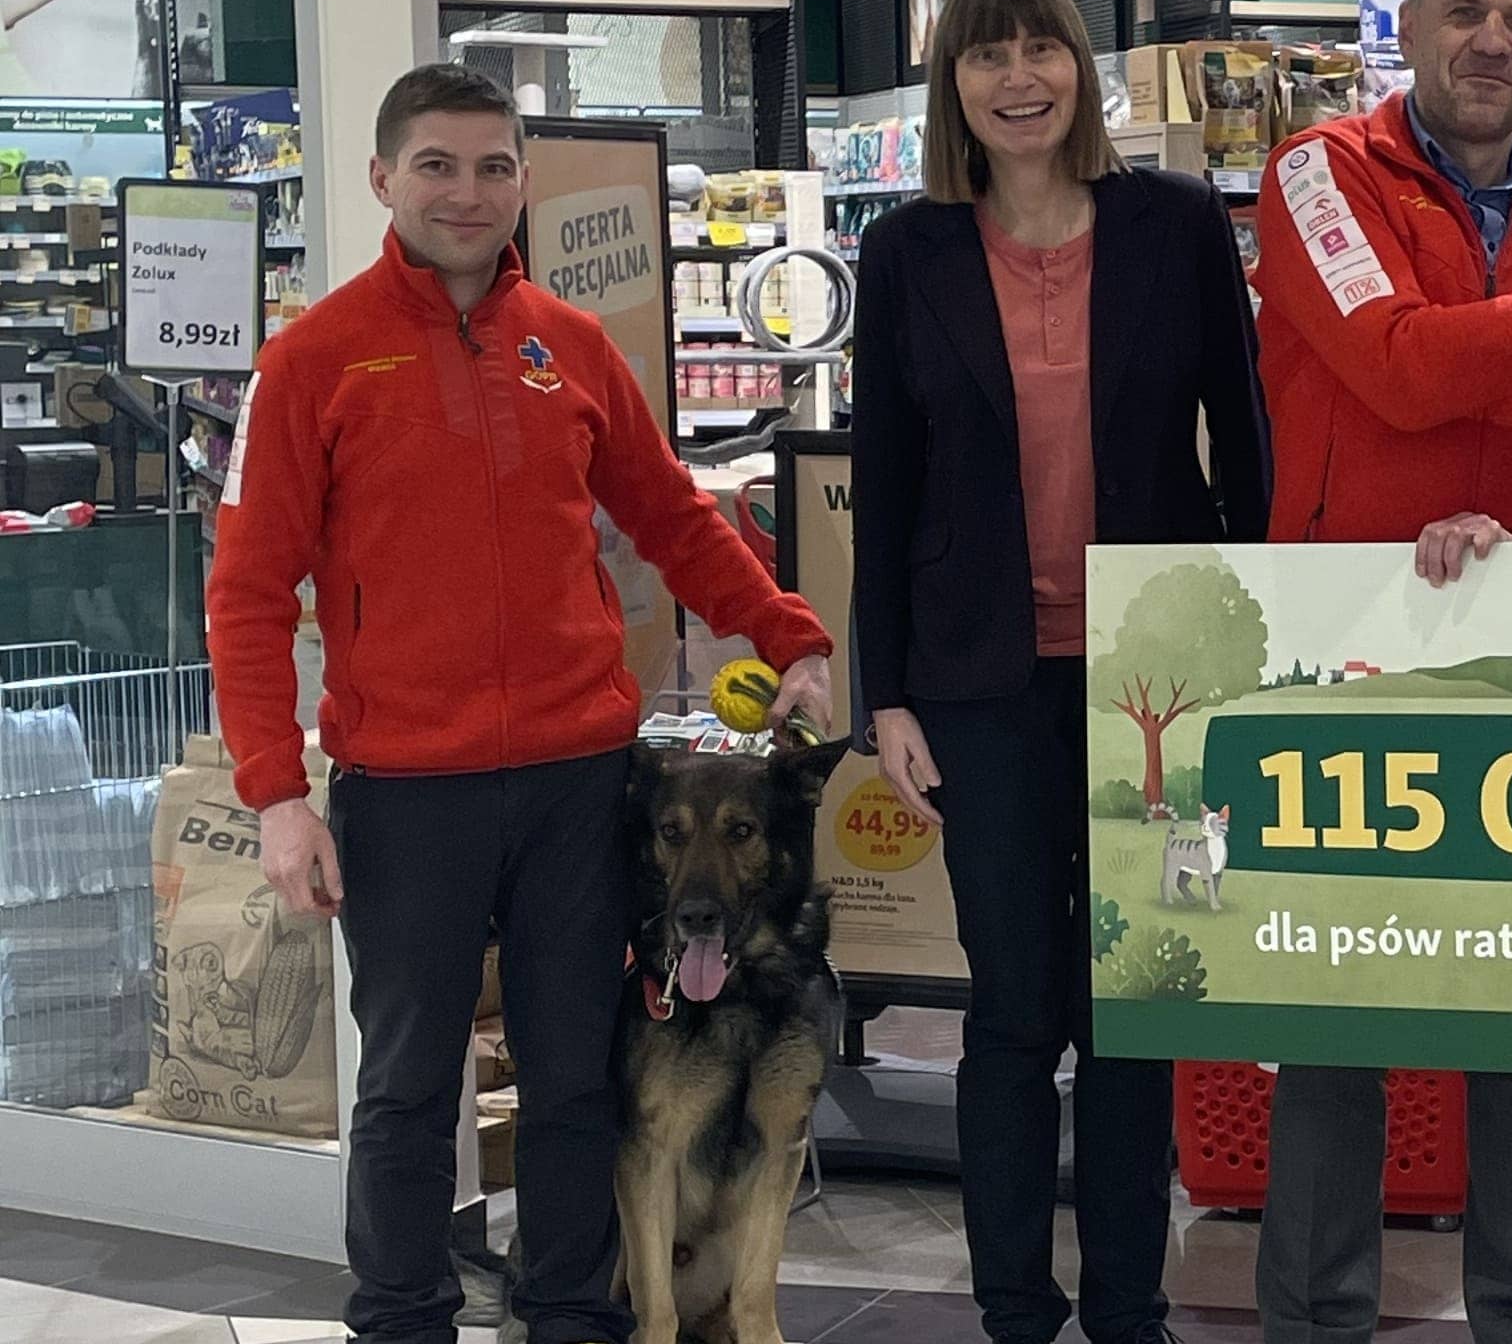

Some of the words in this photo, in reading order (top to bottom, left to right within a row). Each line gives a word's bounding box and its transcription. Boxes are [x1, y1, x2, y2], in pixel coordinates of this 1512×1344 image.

[560, 204, 635, 254] OFERTA
[132, 241, 208, 262] Podkłady
[131, 265, 176, 281] Zolux
[549, 244, 651, 300] SPECJALNA
[159, 322, 241, 347] 8,99zł
[1258, 748, 1446, 854] 115
[872, 877, 884, 891] kg
[1254, 911, 1320, 955] dla
[1329, 914, 1442, 968] psów
[169, 1079, 226, 1109] Corn
[231, 1083, 279, 1117] Cat
